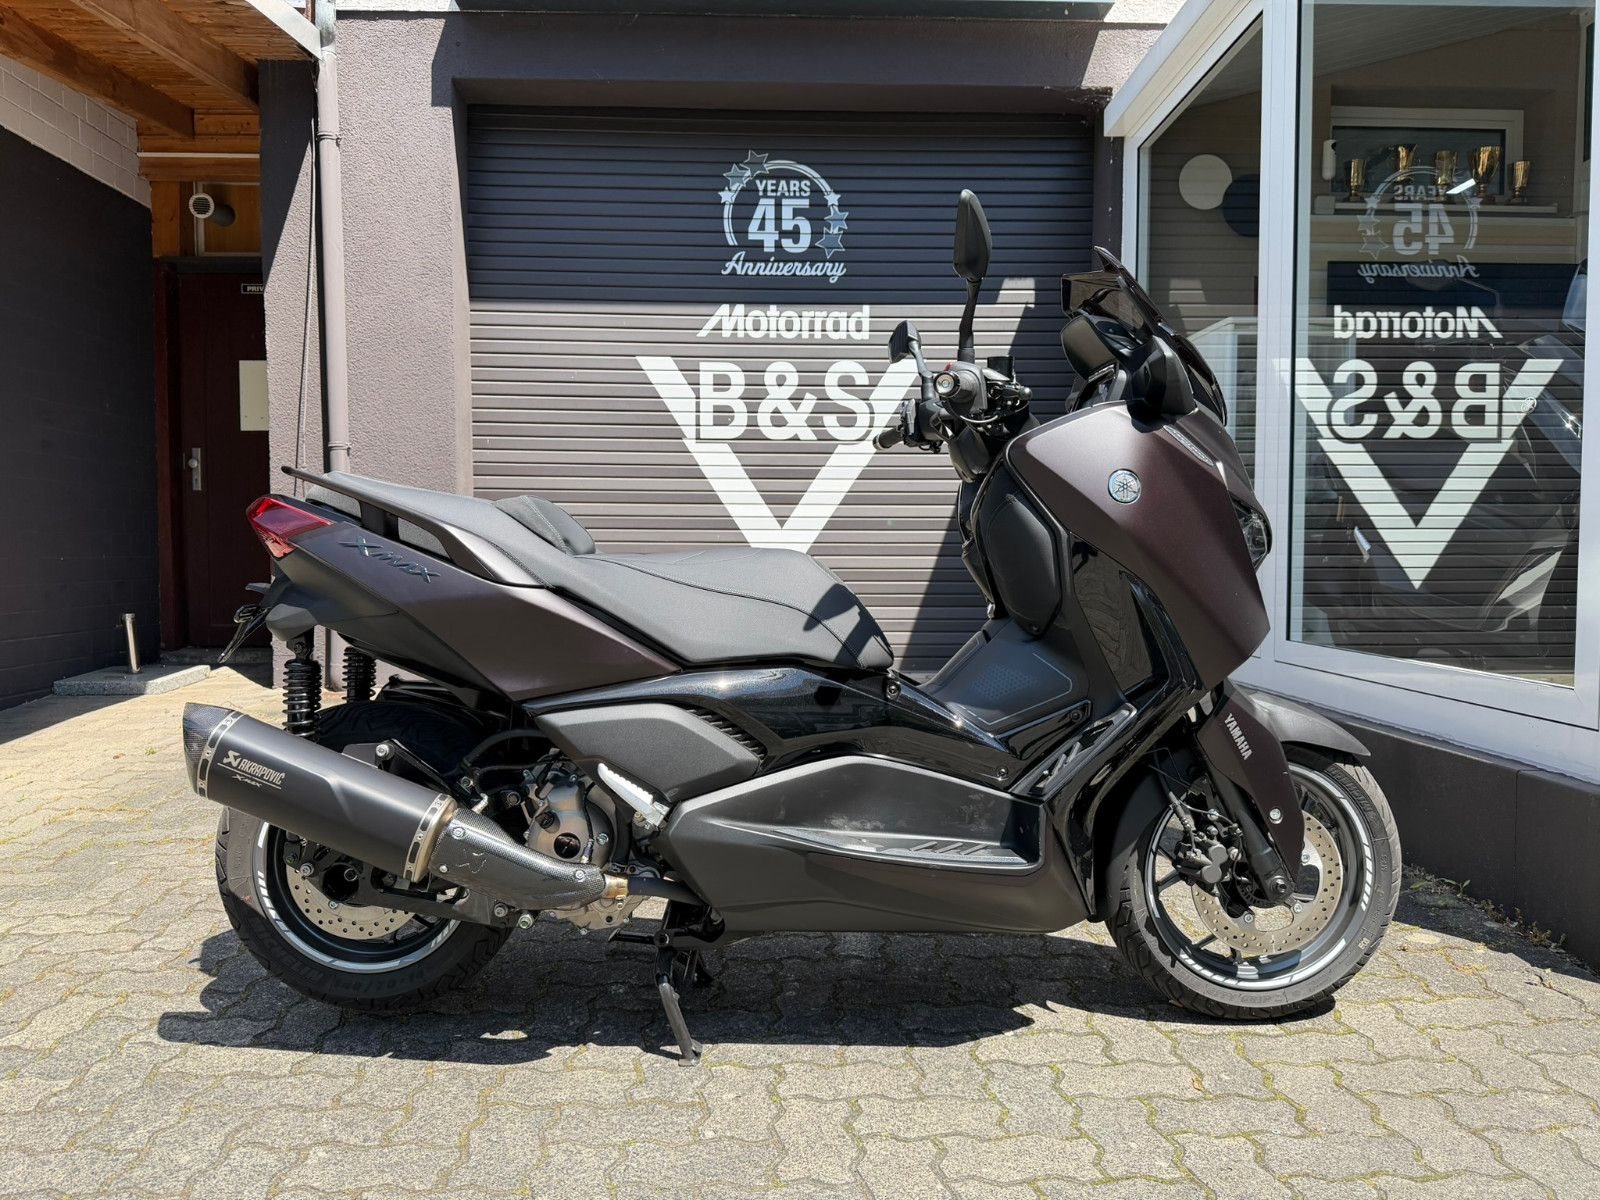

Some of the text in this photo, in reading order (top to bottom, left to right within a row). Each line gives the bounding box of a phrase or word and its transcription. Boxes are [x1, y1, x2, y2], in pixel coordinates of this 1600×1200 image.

[755, 179, 811, 196] YEARS
[747, 198, 812, 253] 45
[721, 251, 847, 283] Anniversary
[696, 304, 870, 340] Motorrad
[699, 360, 870, 441] B&S
[1224, 712, 1253, 760] YAMAHA
